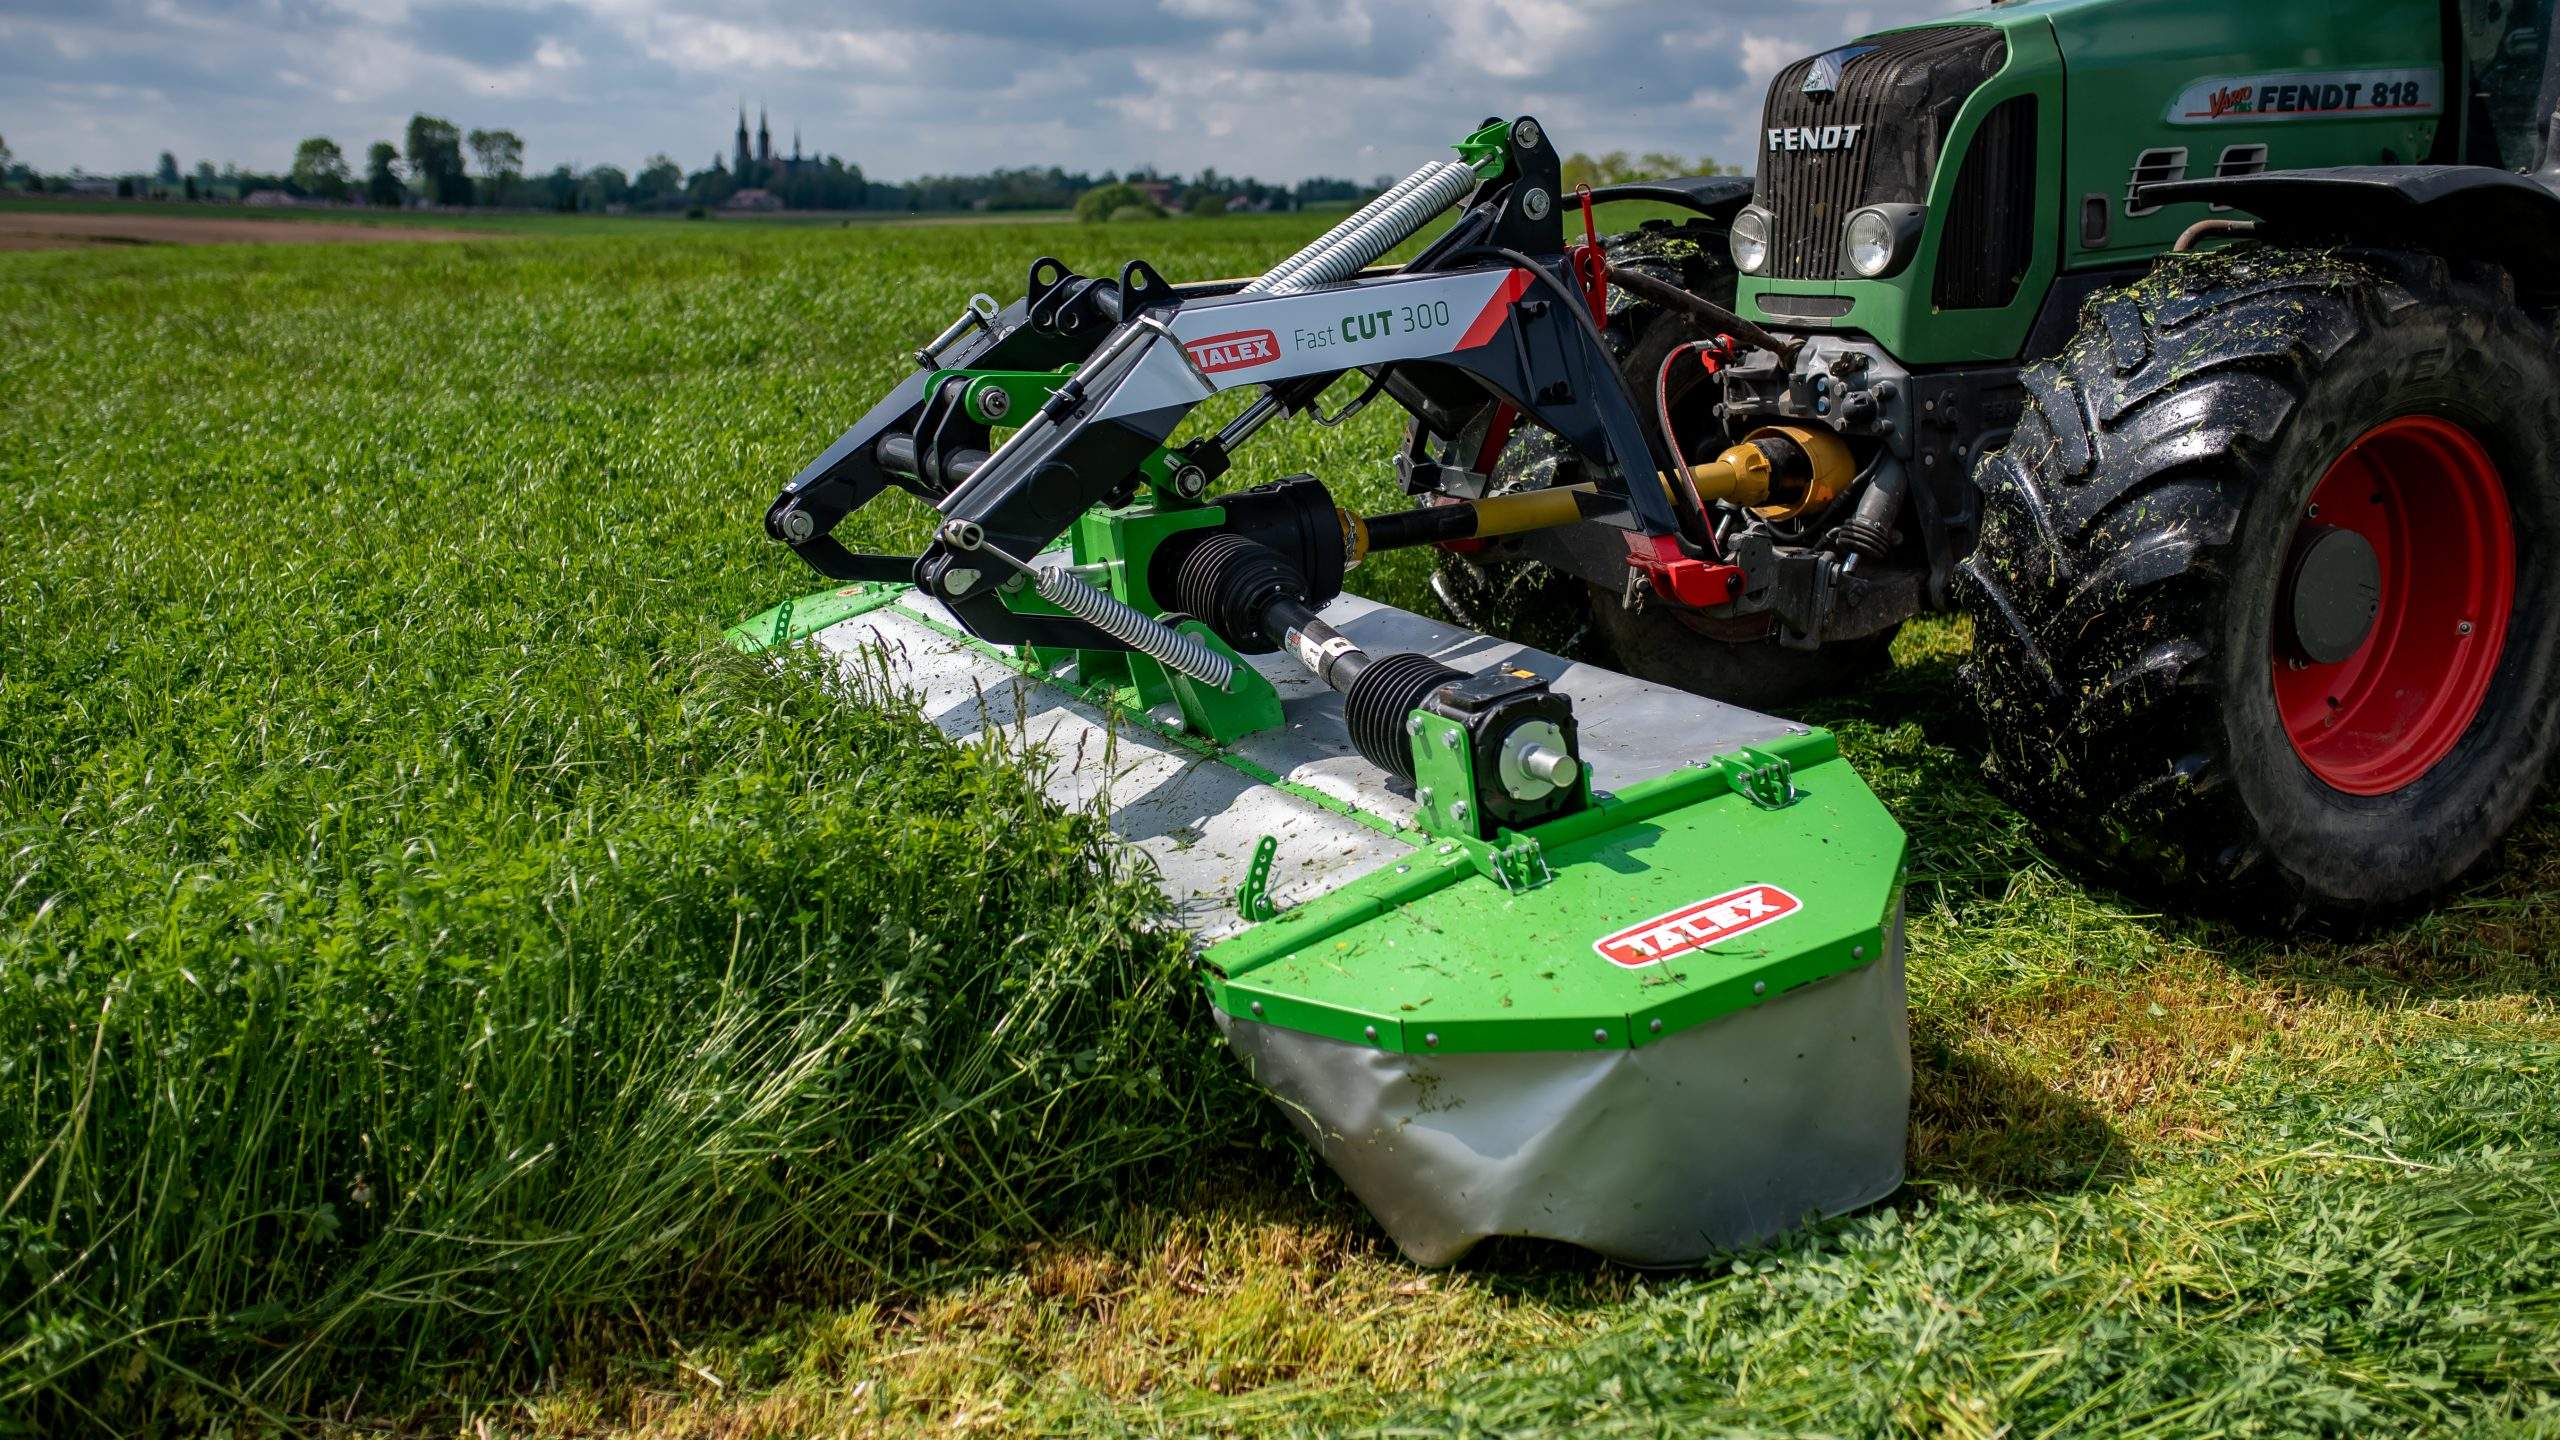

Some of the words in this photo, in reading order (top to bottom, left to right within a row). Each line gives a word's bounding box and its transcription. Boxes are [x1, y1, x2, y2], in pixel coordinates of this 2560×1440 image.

[2257, 84, 2361, 112] FENDT
[2371, 81, 2419, 107] 818
[1768, 125, 1862, 151] FENDT
[1295, 326, 1335, 351] Fast
[1341, 310, 1393, 343] CUT
[1401, 301, 1449, 333] 300
[1187, 333, 1272, 368] TALEX
[1605, 889, 1782, 957] TALEX
